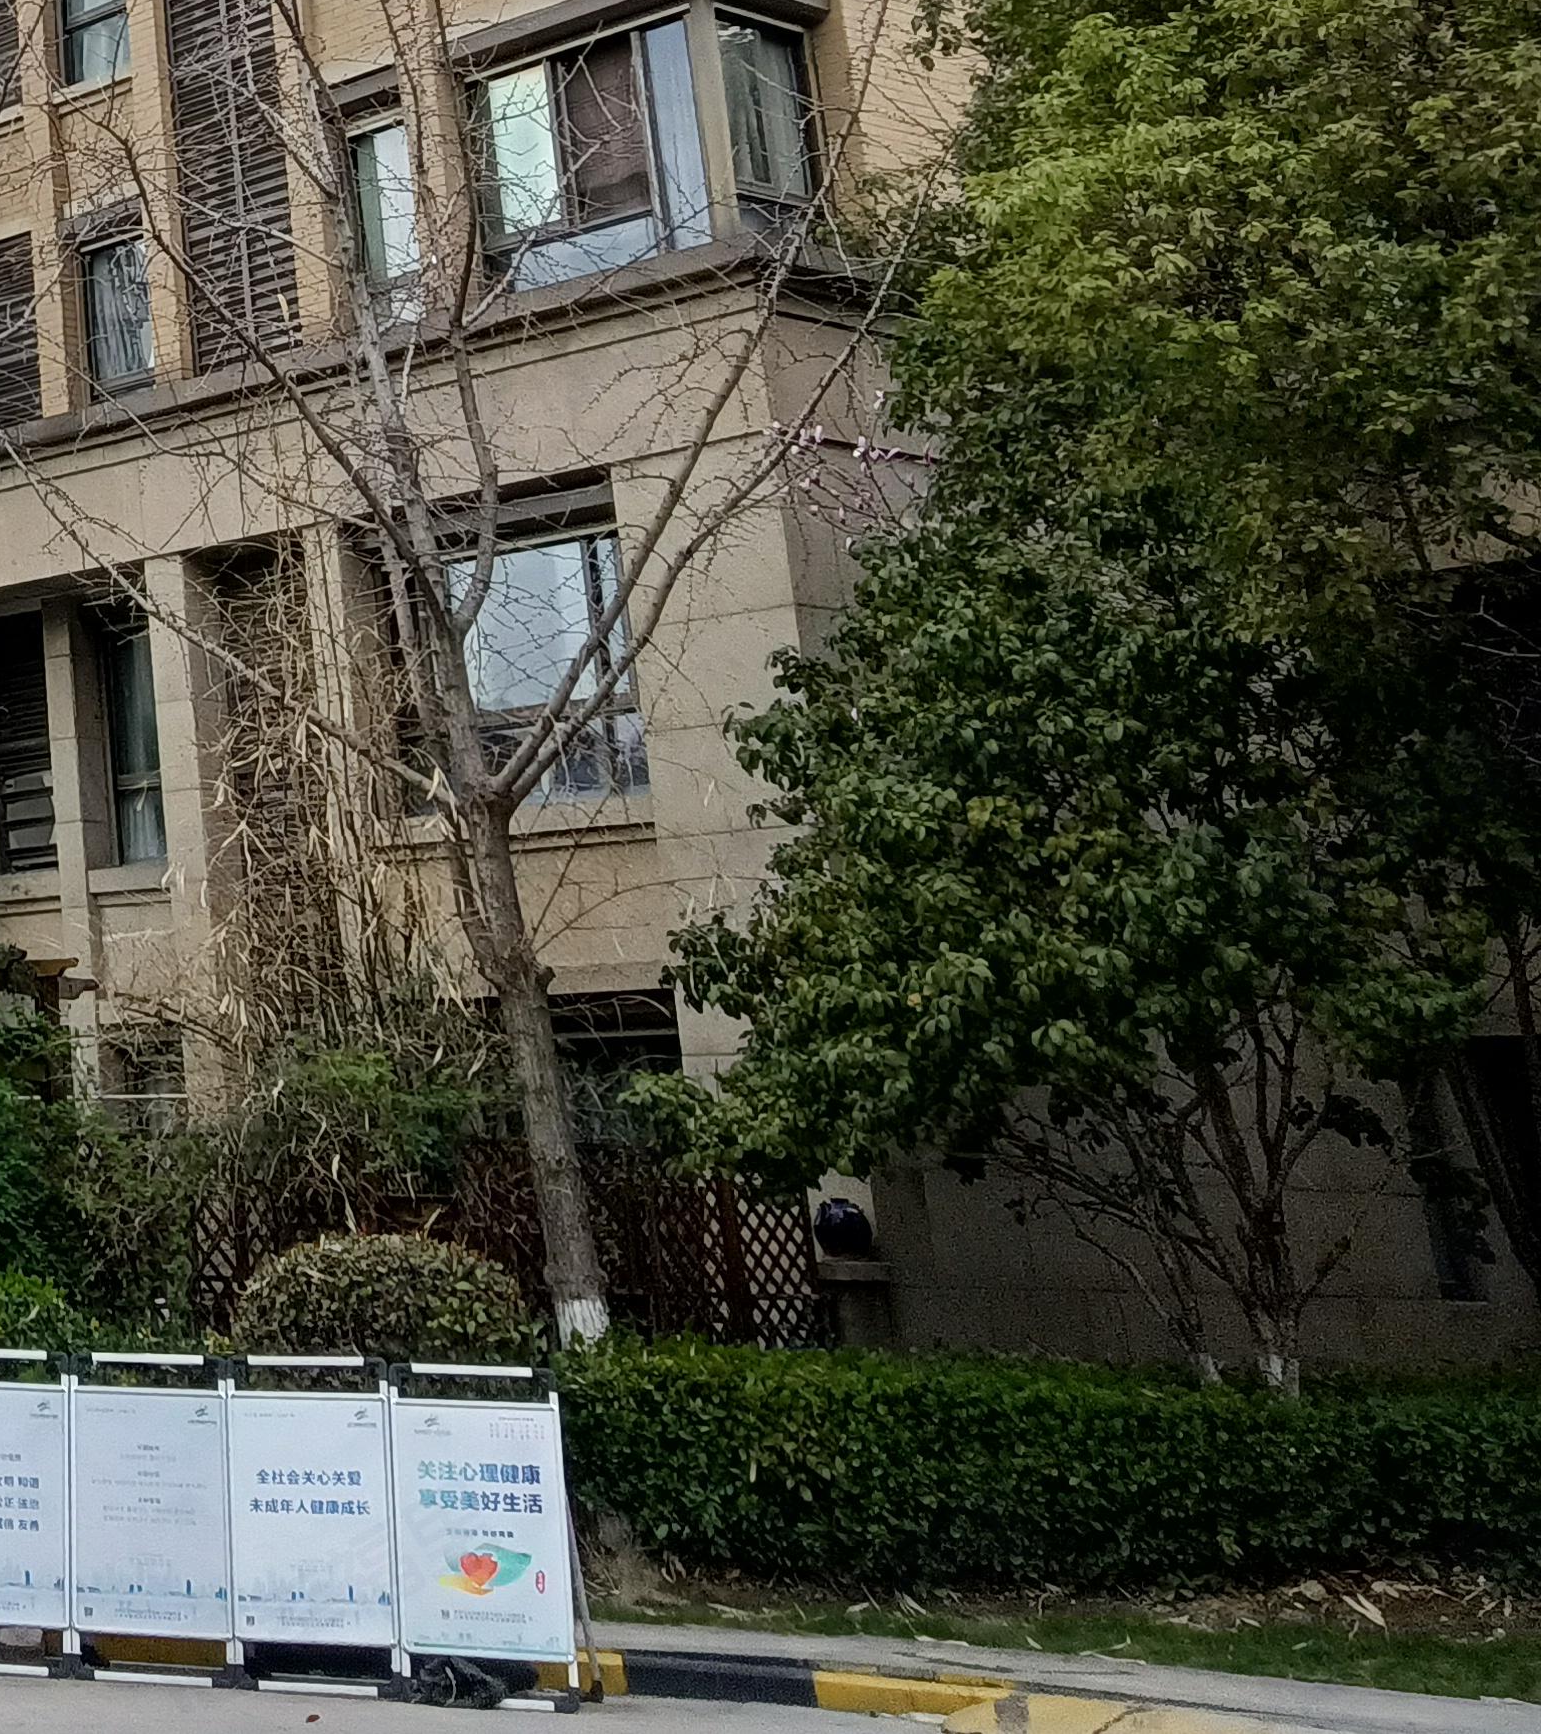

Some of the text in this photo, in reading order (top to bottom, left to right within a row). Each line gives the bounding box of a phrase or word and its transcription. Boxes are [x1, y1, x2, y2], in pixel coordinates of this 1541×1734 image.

[255, 1469, 362, 1487] 全社会关心关爱
[417, 1460, 541, 1485] 关注心理健康
[249, 1497, 371, 1516] 未成年人健康成长
[418, 1488, 543, 1515] 享受美好生活
